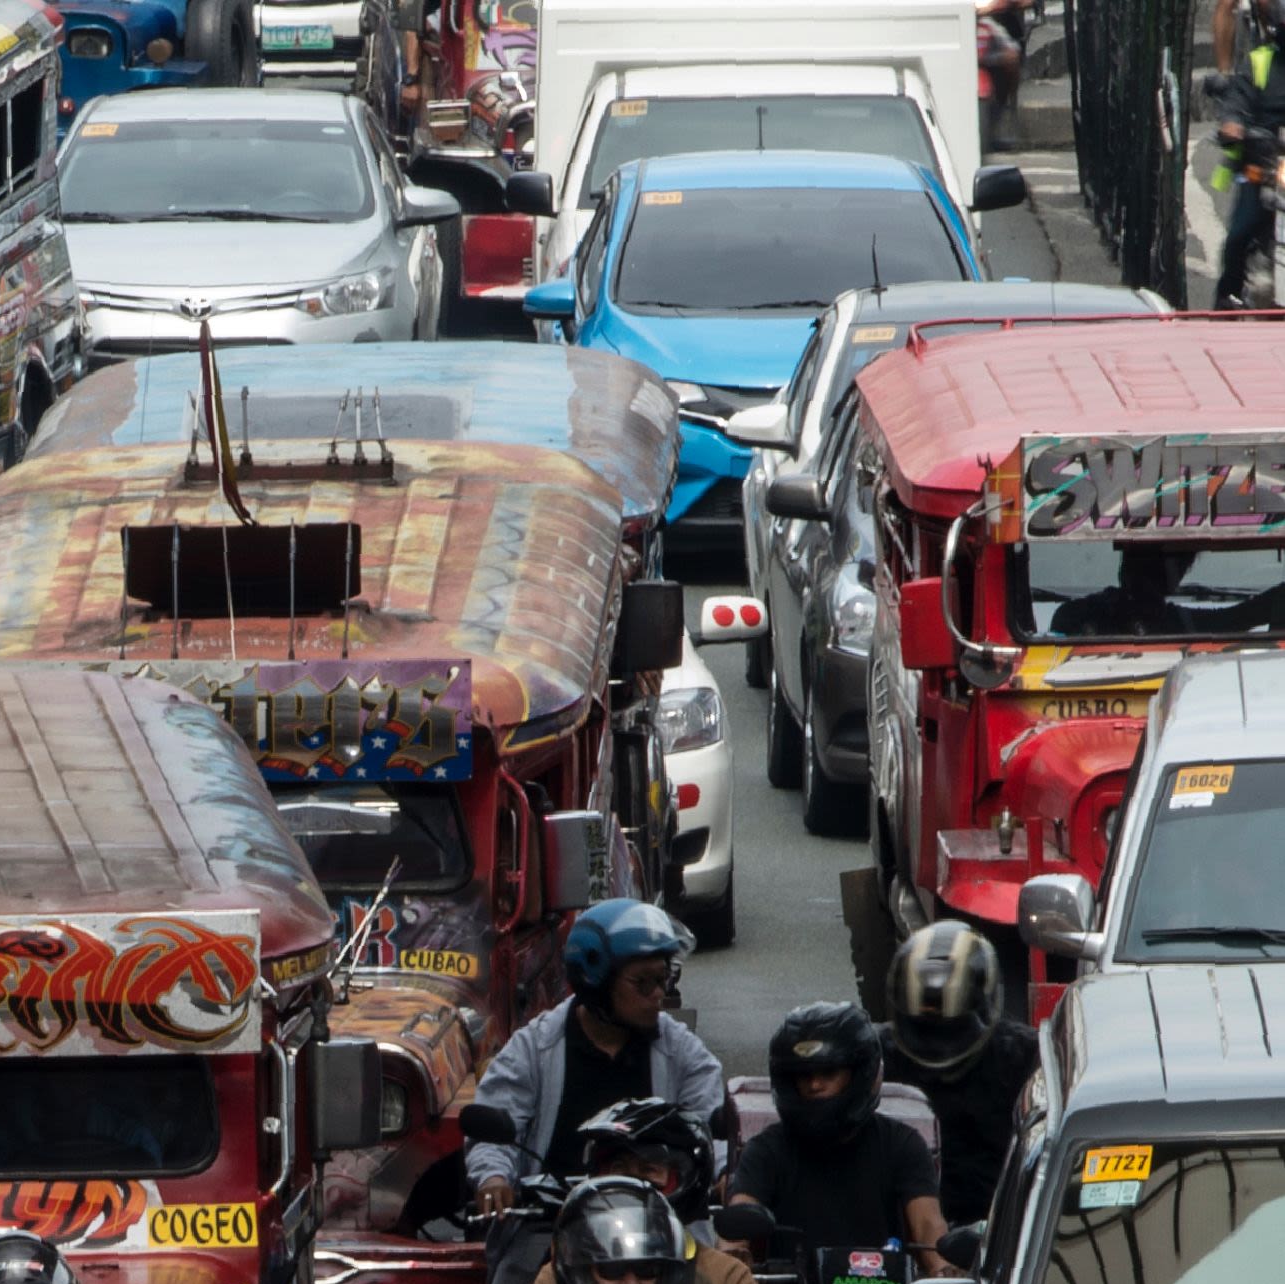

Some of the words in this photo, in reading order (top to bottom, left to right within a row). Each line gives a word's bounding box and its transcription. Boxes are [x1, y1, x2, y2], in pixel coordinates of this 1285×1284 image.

[1042, 698, 1129, 719] CUBAO
[1189, 773, 1229, 789] 6026
[404, 955, 471, 975] CUBAO
[1100, 1154, 1148, 1172] 7727
[150, 1206, 253, 1246] COGEO
